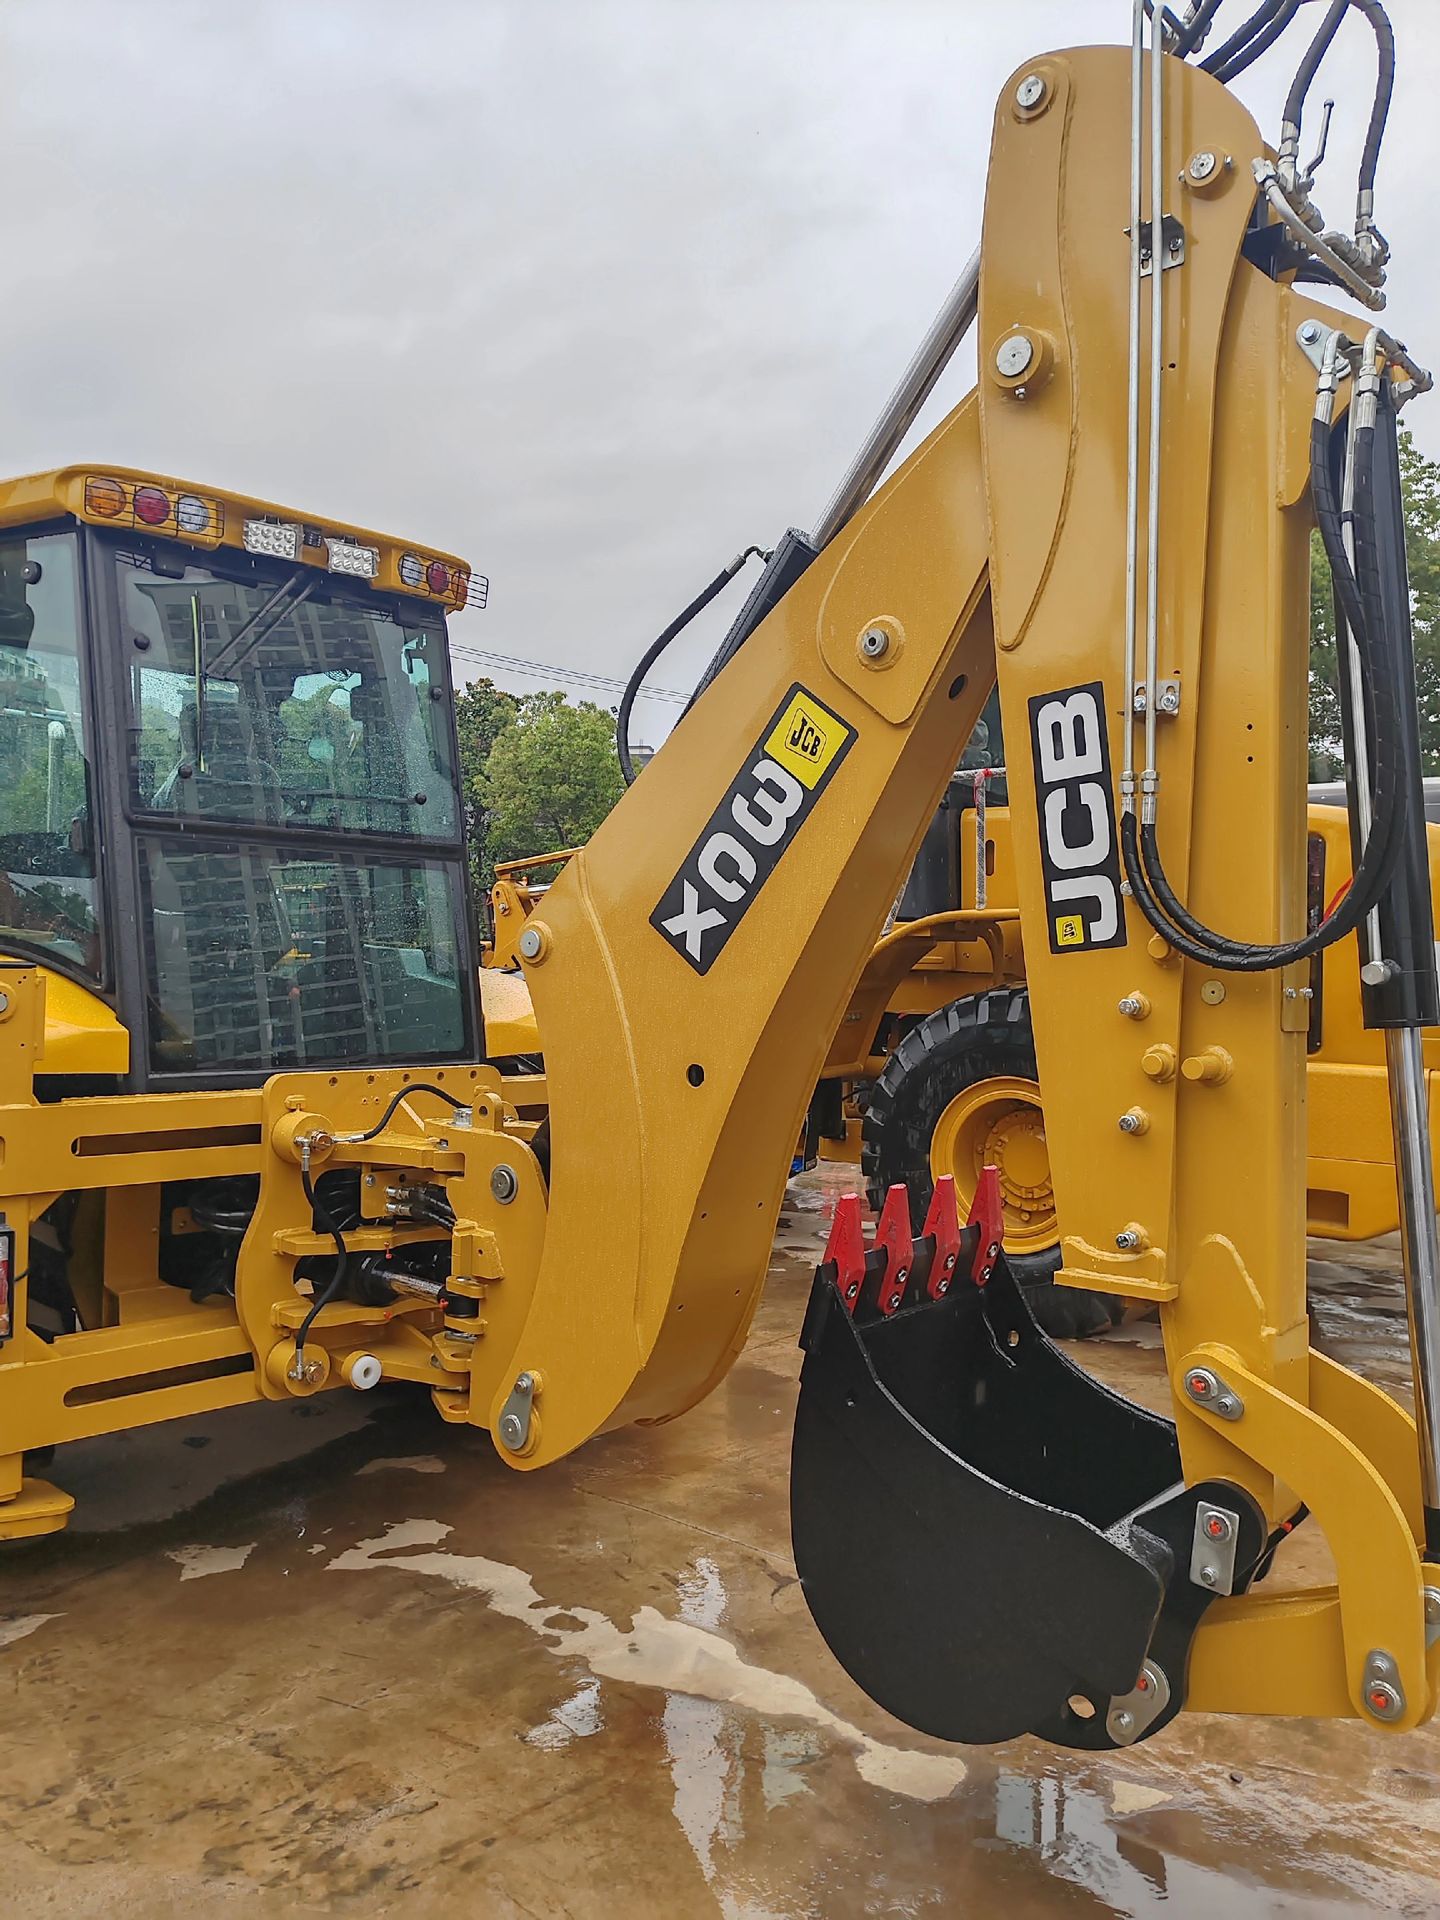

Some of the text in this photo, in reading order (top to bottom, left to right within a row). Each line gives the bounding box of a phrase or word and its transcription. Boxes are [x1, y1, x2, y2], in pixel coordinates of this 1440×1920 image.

[789, 715, 821, 757] JCB
[1037, 692, 1118, 942] JCB
[660, 758, 804, 963] 3CX
